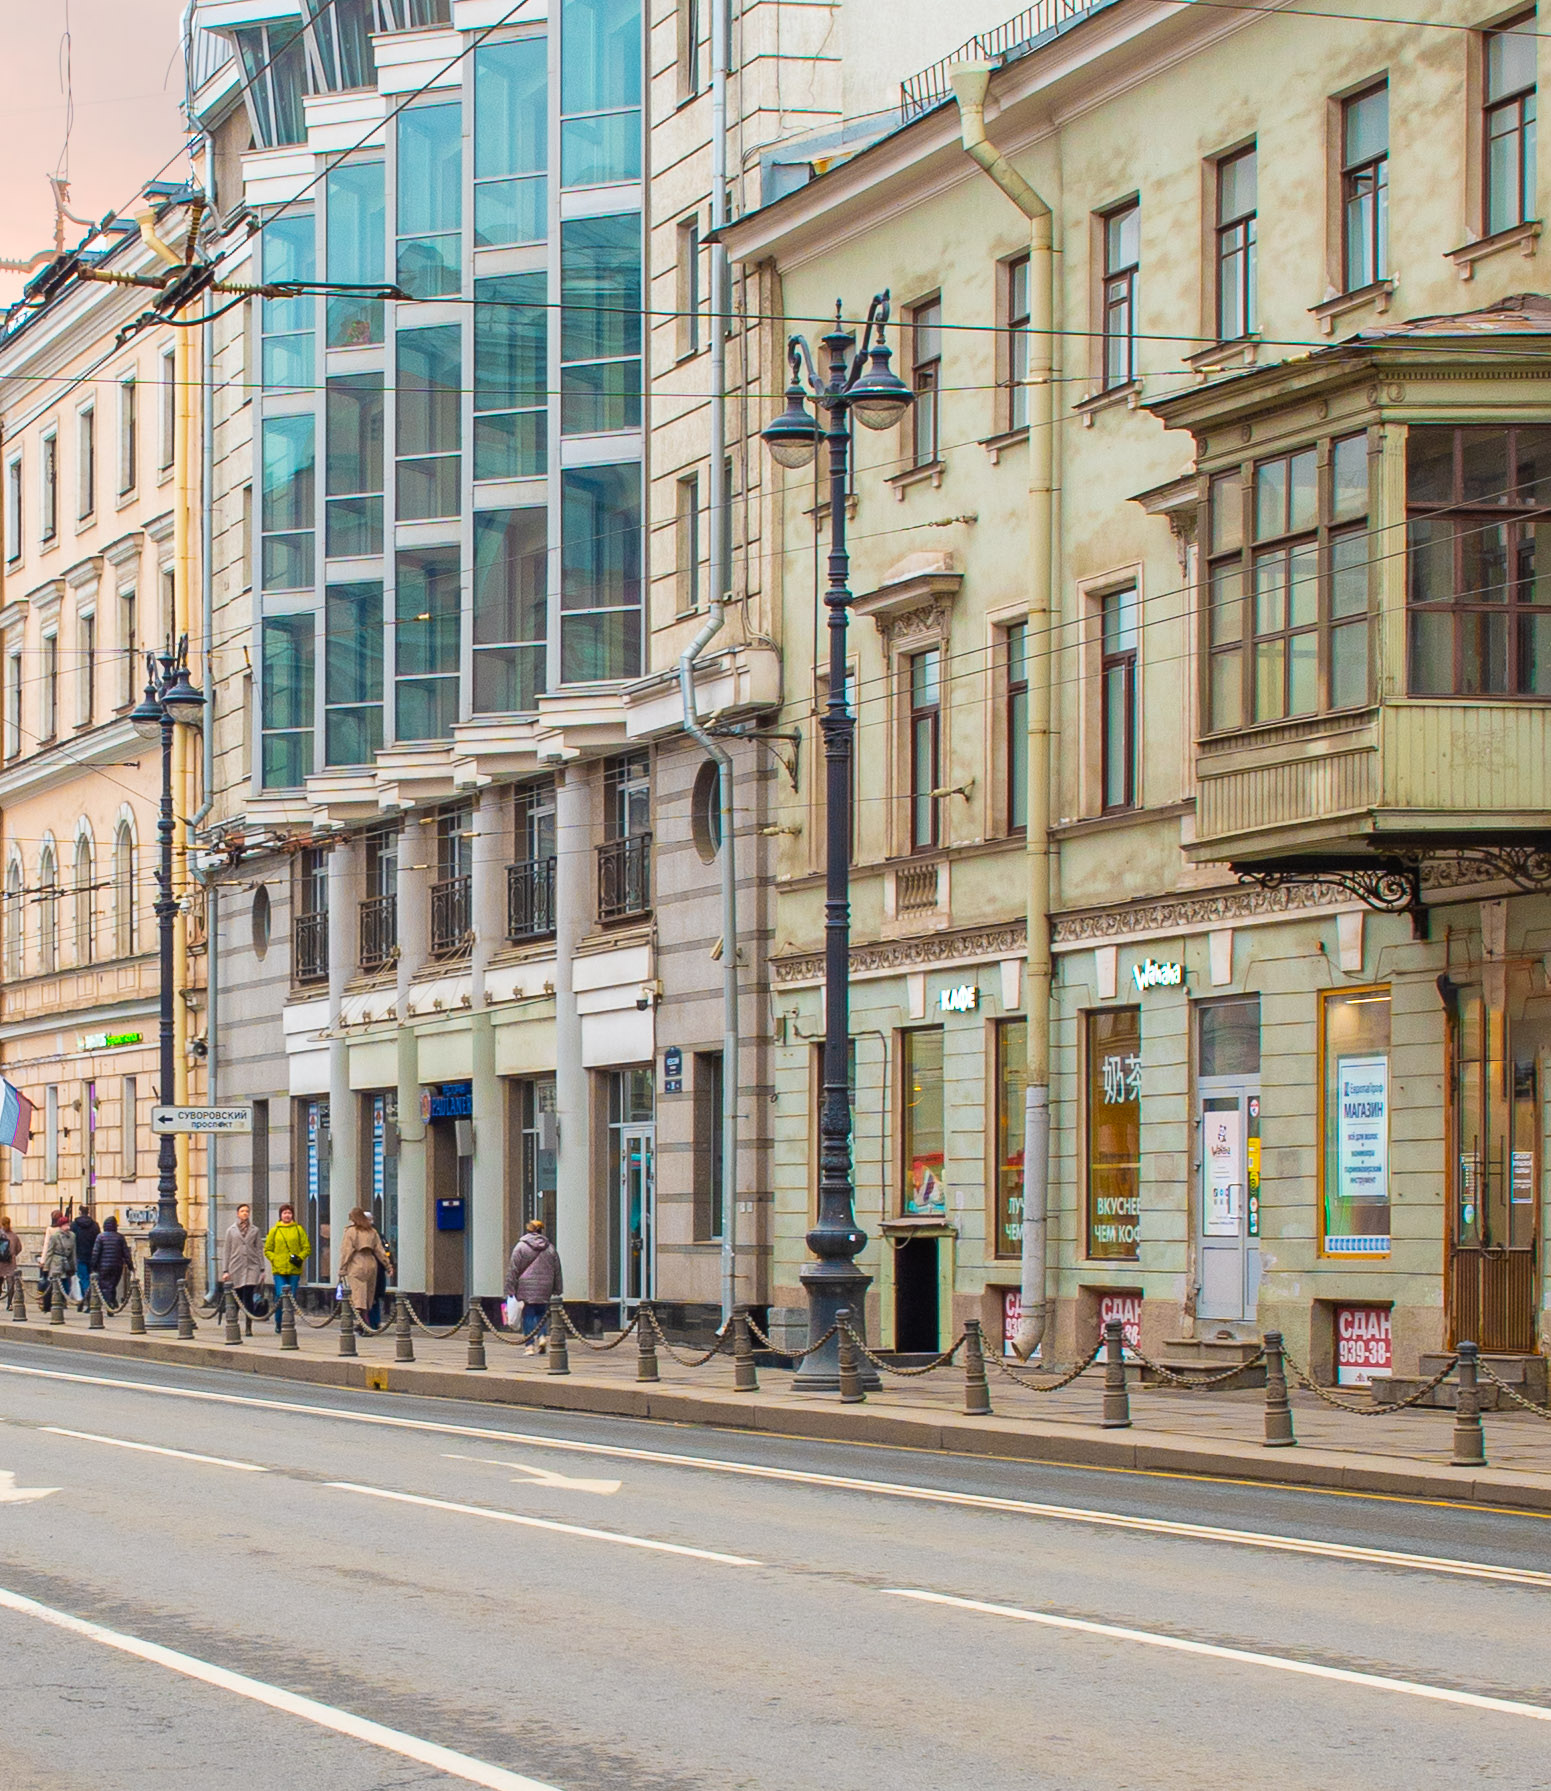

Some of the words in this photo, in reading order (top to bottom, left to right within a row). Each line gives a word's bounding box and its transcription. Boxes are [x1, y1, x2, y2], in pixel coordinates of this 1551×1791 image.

[1133, 958, 1182, 991] Wahaha
[940, 984, 976, 1012] КАФЕ
[178, 1110, 247, 1119] СУВОРОВСКИЙ
[1344, 1102, 1383, 1118] МАГАЗИН
[1094, 1224, 1116, 1243] ЧЕМ
[1340, 1311, 1391, 1340] СДАН
[1340, 1340, 1391, 1364] 939-38-
